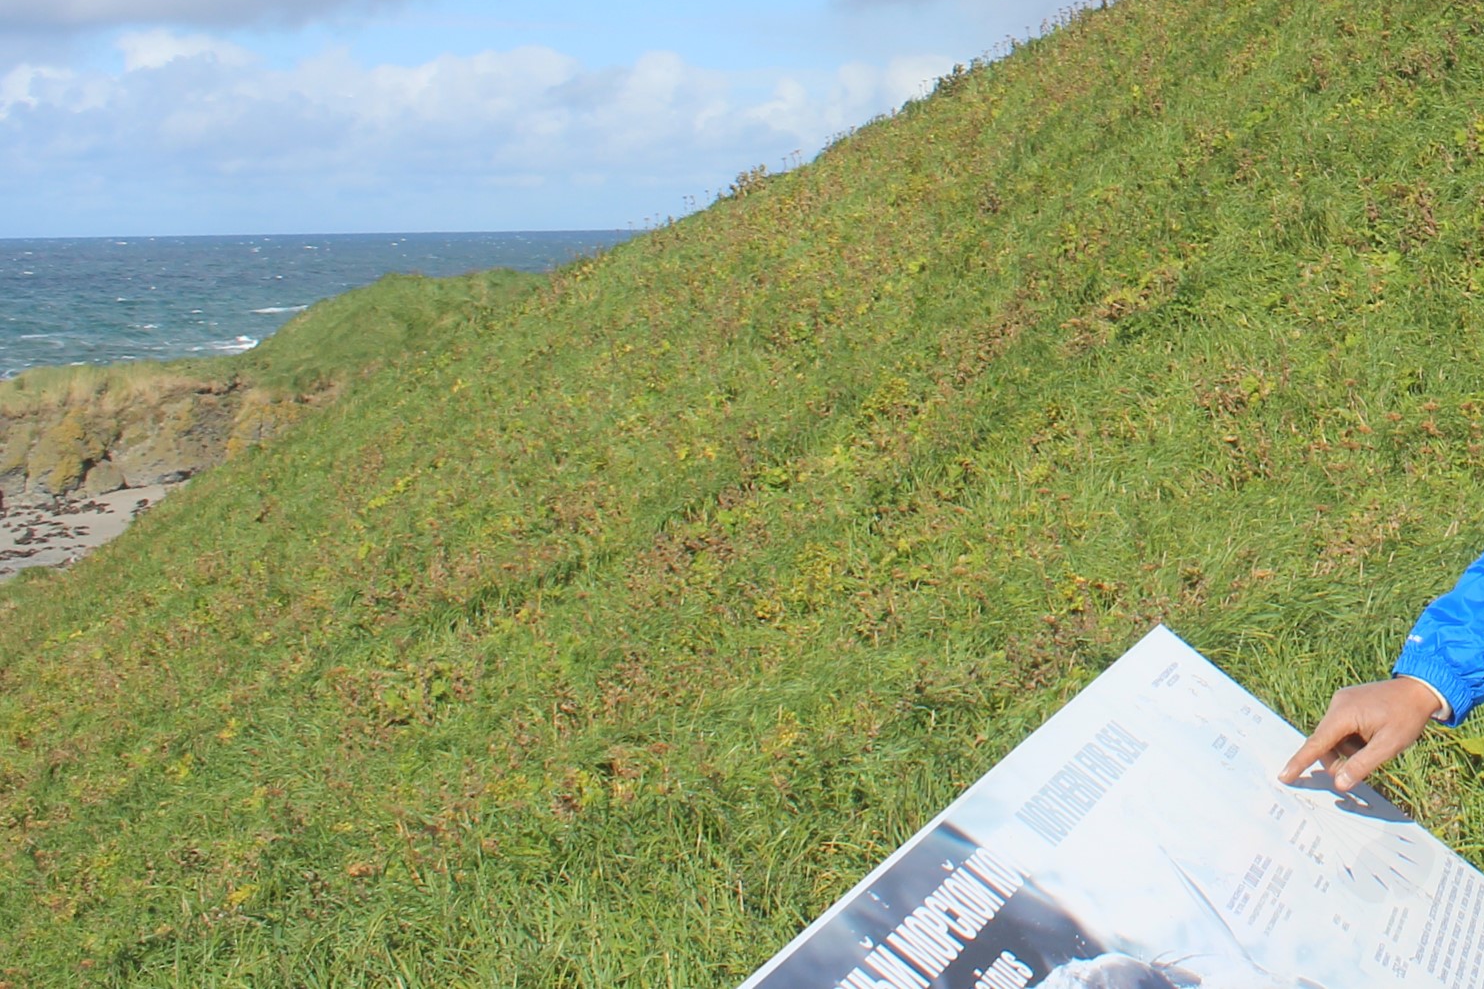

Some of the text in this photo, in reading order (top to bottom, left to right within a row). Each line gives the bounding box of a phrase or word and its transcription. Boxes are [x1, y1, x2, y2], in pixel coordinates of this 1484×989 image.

[1014, 719, 1149, 848] NORTHERN FUR SEAL
[886, 859, 1005, 979] МОРСКОЙ
